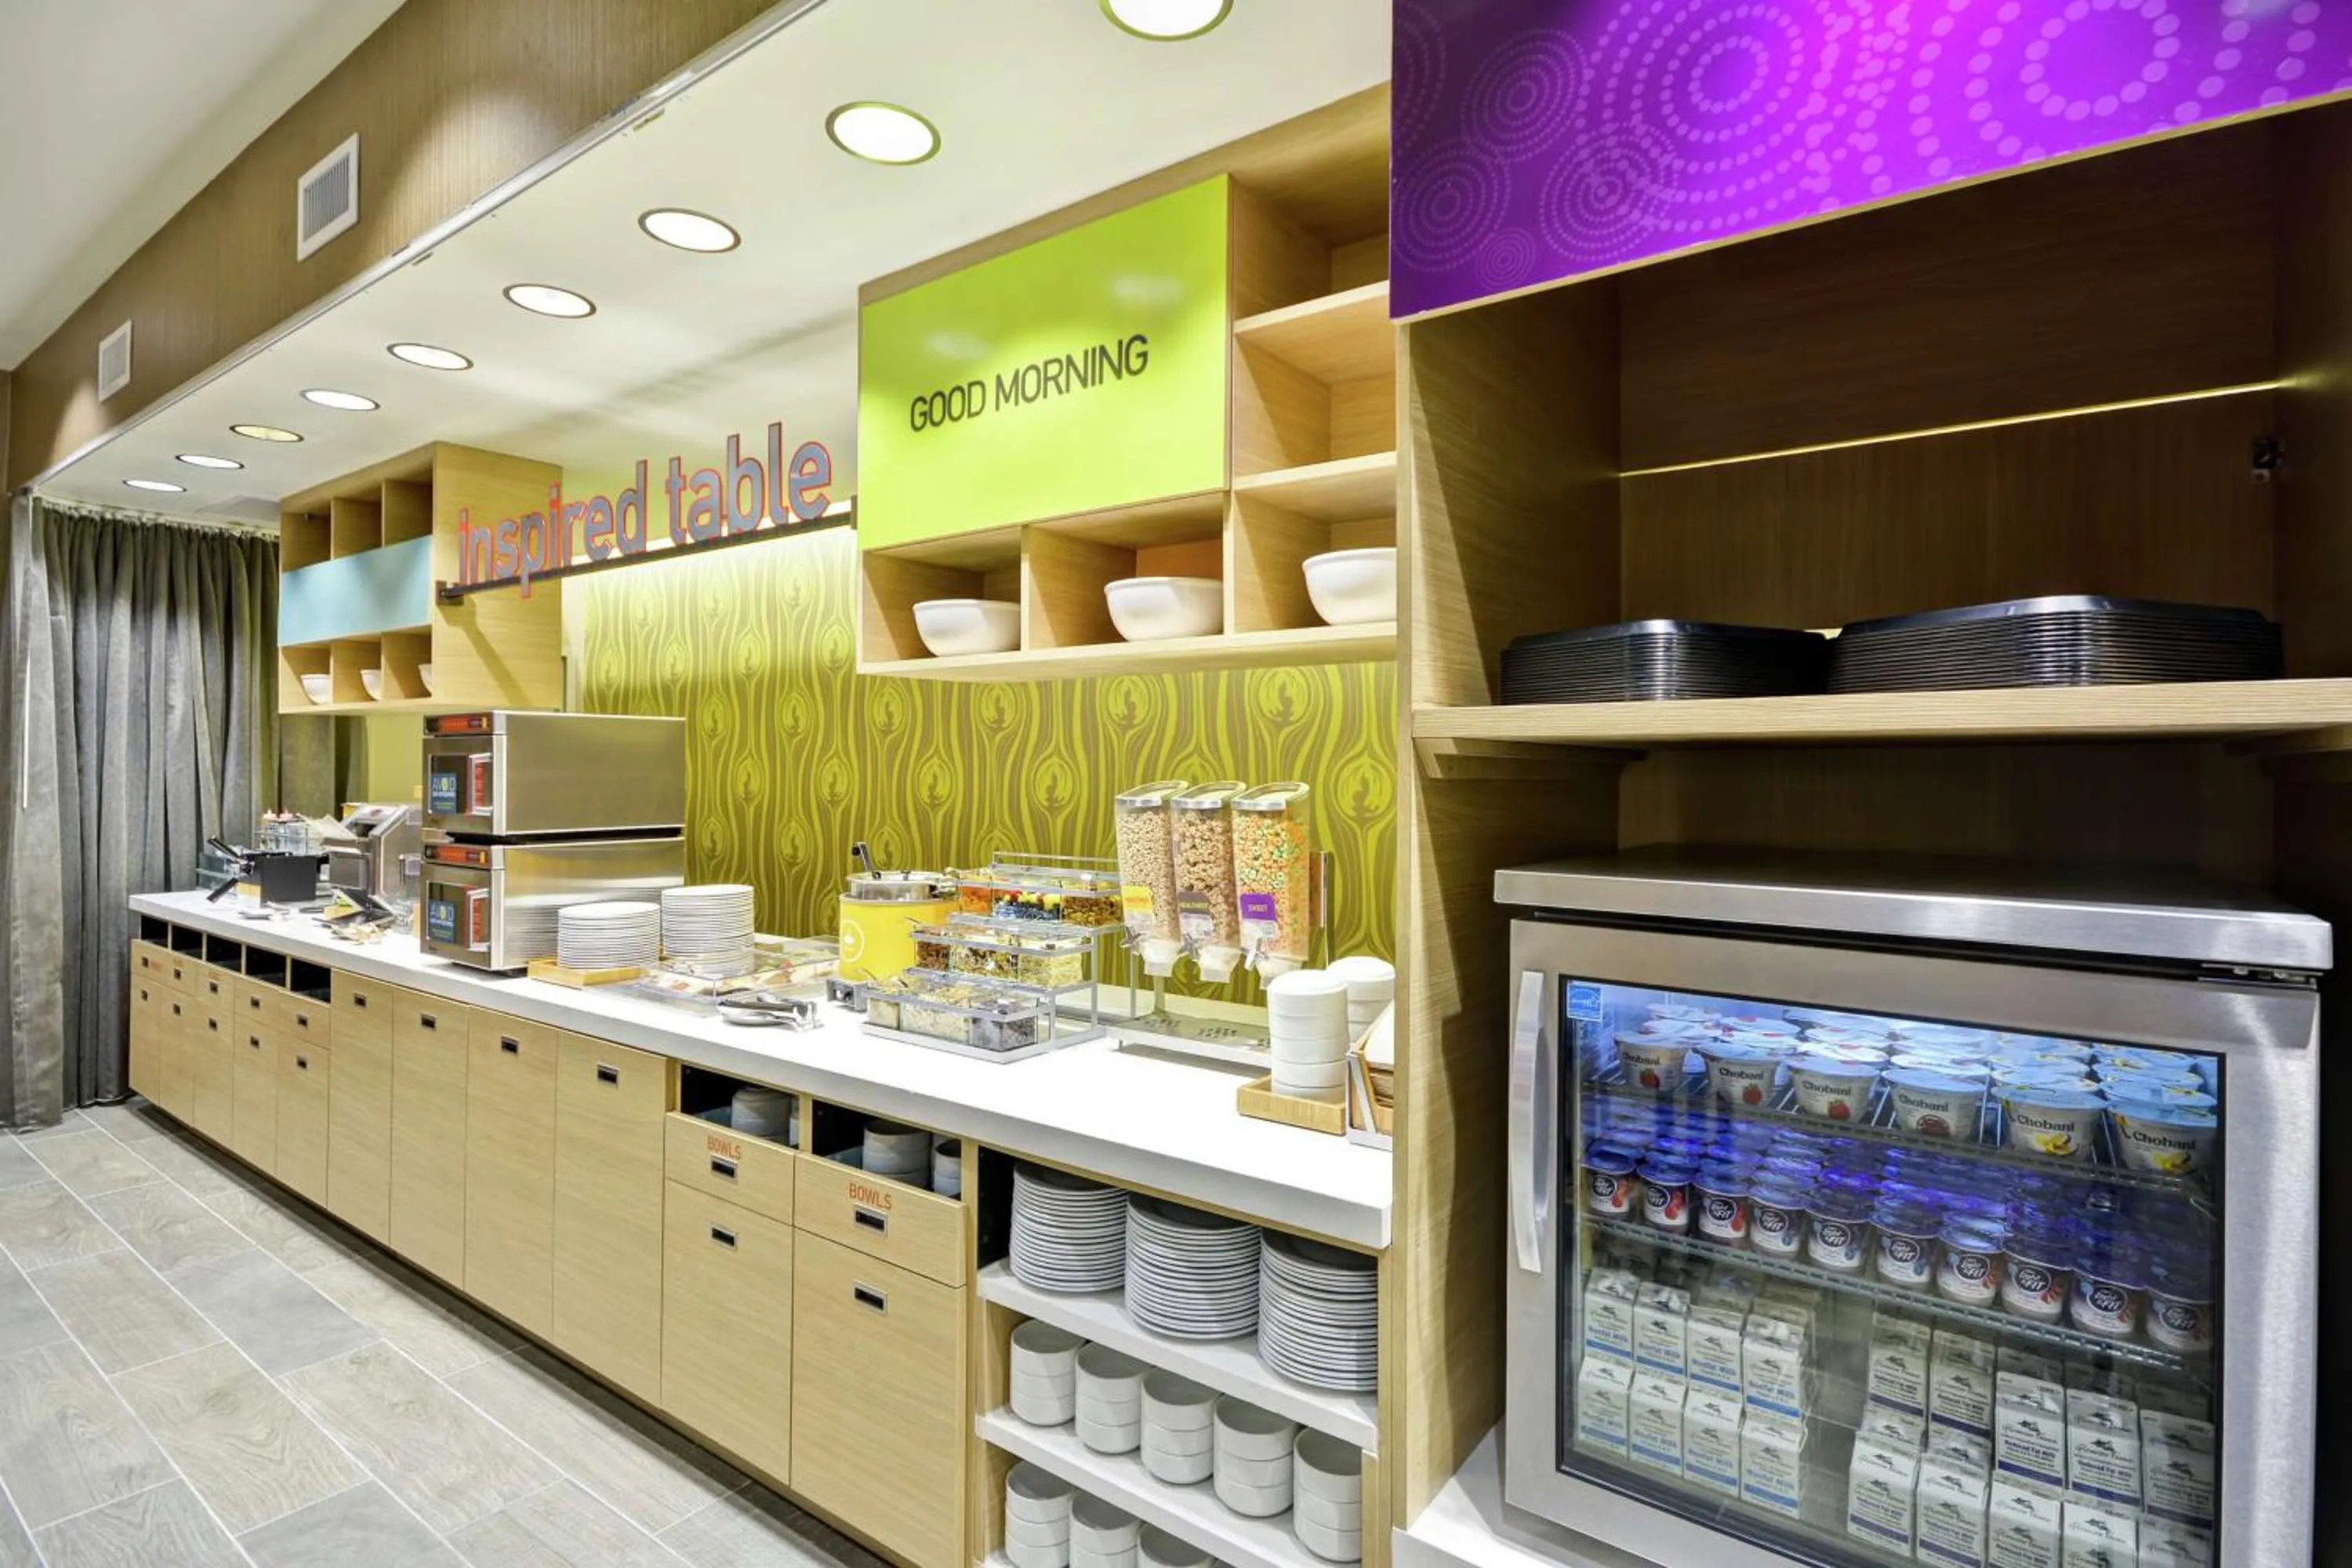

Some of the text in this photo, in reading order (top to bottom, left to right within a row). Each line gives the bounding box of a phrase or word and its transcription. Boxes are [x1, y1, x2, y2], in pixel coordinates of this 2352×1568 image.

[910, 334, 1149, 432] GOOD MORNING
[459, 422, 832, 599] inspired table
[1719, 1067, 1765, 1080] Chobani
[1804, 1081, 1852, 1097] Chobani
[1898, 1094, 1949, 1112] Chobani
[2017, 1115, 2075, 1133] Chobani
[707, 1136, 741, 1160] BOWLS
[2132, 1131, 2196, 1150] Chobani
[848, 1182, 893, 1210] BOWLS
